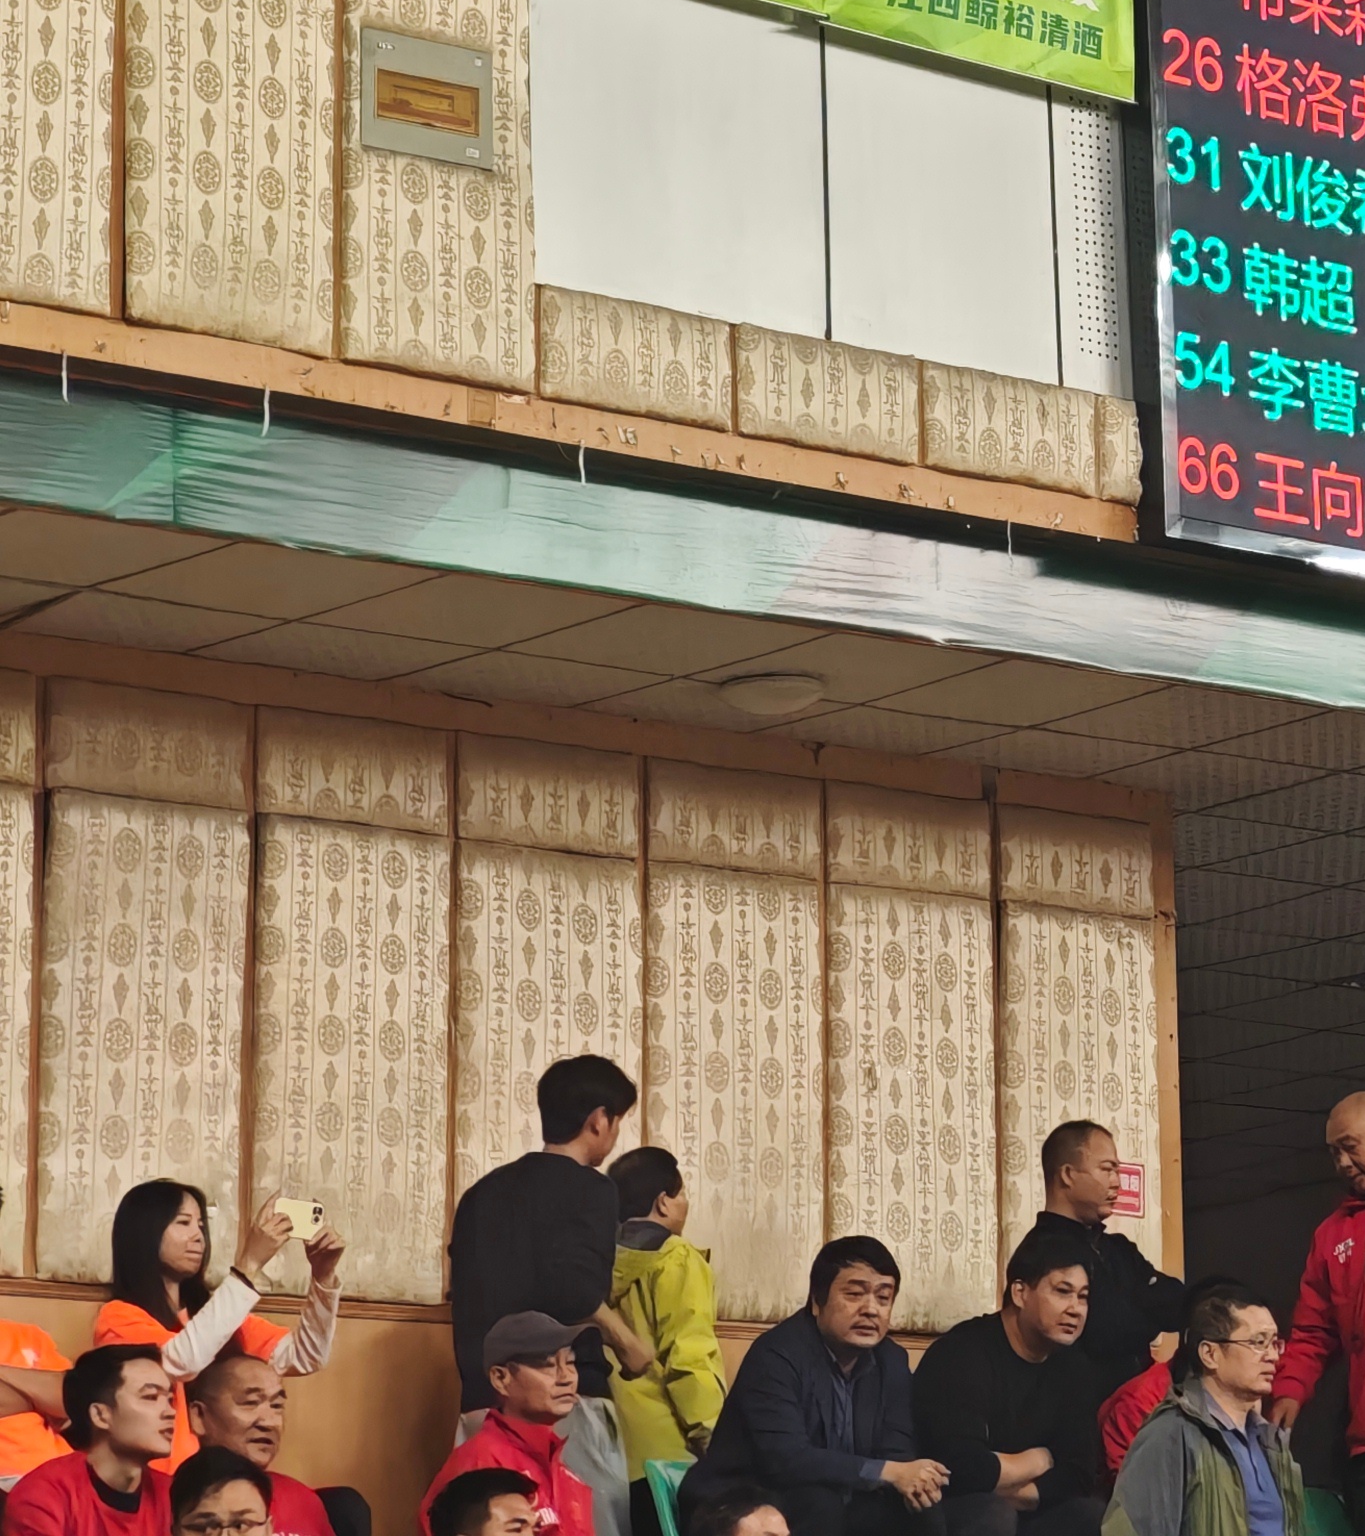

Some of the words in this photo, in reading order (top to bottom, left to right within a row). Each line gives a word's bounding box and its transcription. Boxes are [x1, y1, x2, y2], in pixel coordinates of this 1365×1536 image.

[1161, 28, 1225, 94] 26
[1166, 126, 1224, 193] 31
[1170, 229, 1232, 294] 33
[1243, 240, 1358, 337] 韩超
[1172, 331, 1237, 398] 54
[1176, 435, 1241, 501] 66
